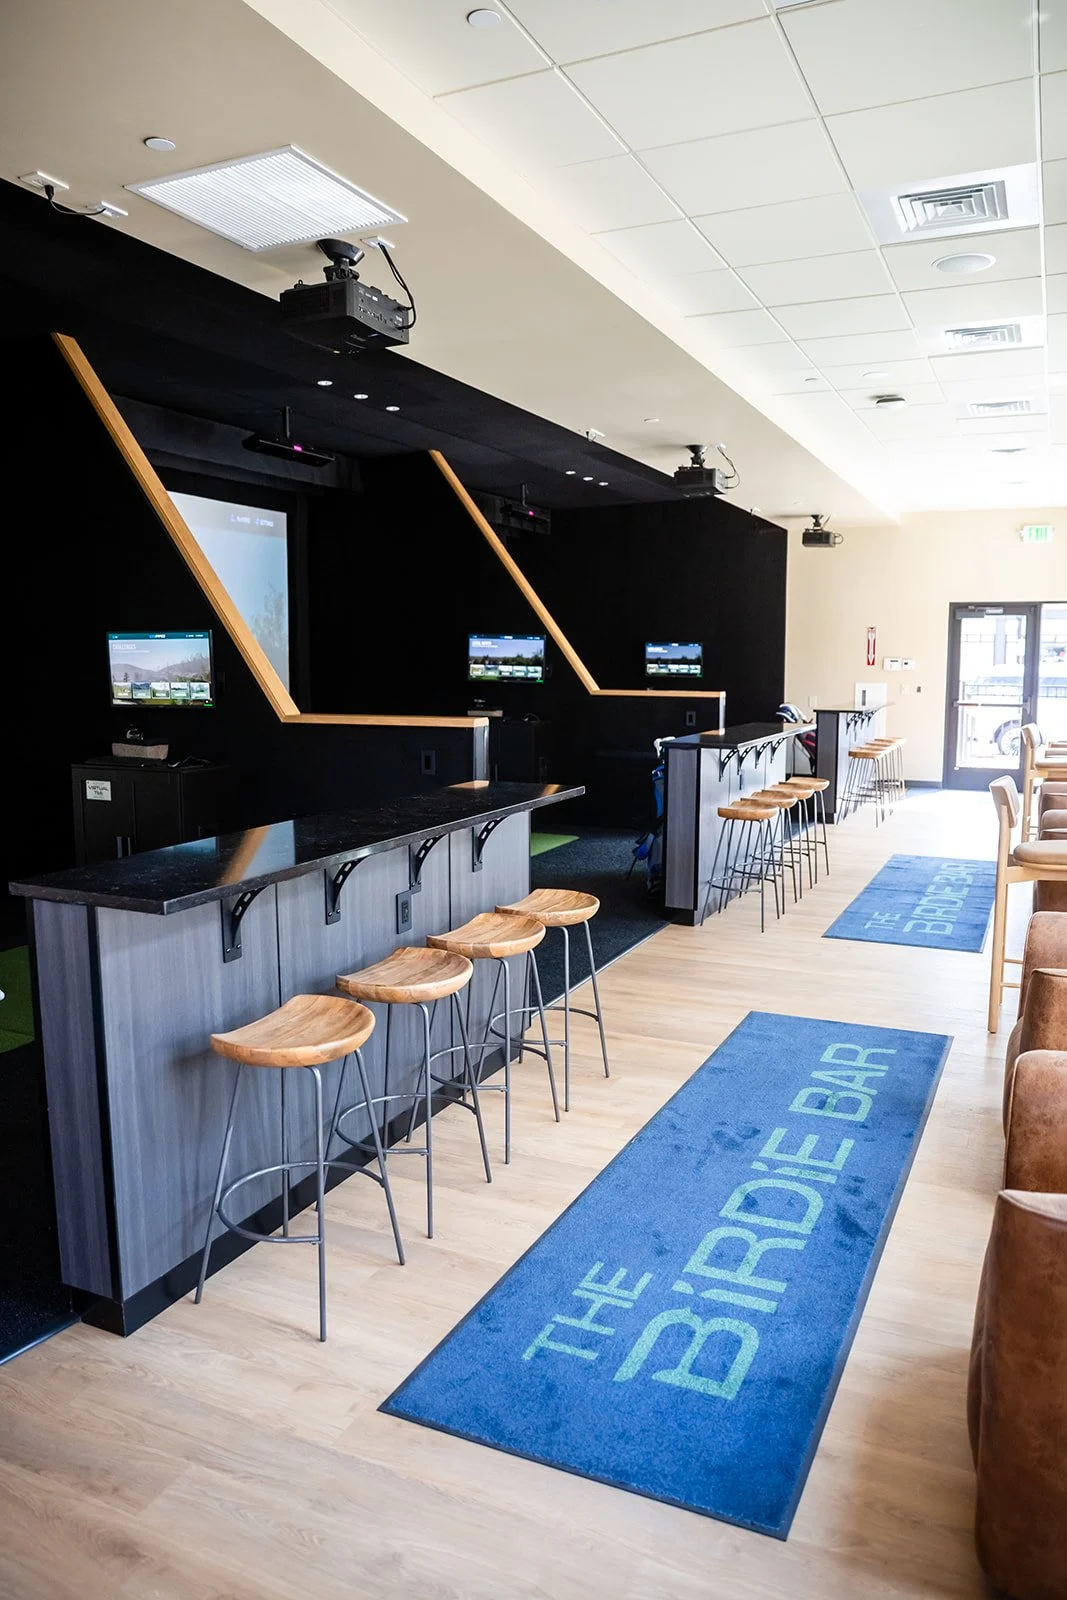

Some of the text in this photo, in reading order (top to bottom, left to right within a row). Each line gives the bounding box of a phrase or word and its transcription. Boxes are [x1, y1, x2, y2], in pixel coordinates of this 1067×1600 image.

[1028, 527, 1048, 541] EXIT
[864, 911, 901, 930] THE
[788, 1042, 897, 1122] BAR
[522, 1261, 653, 1361] THE
